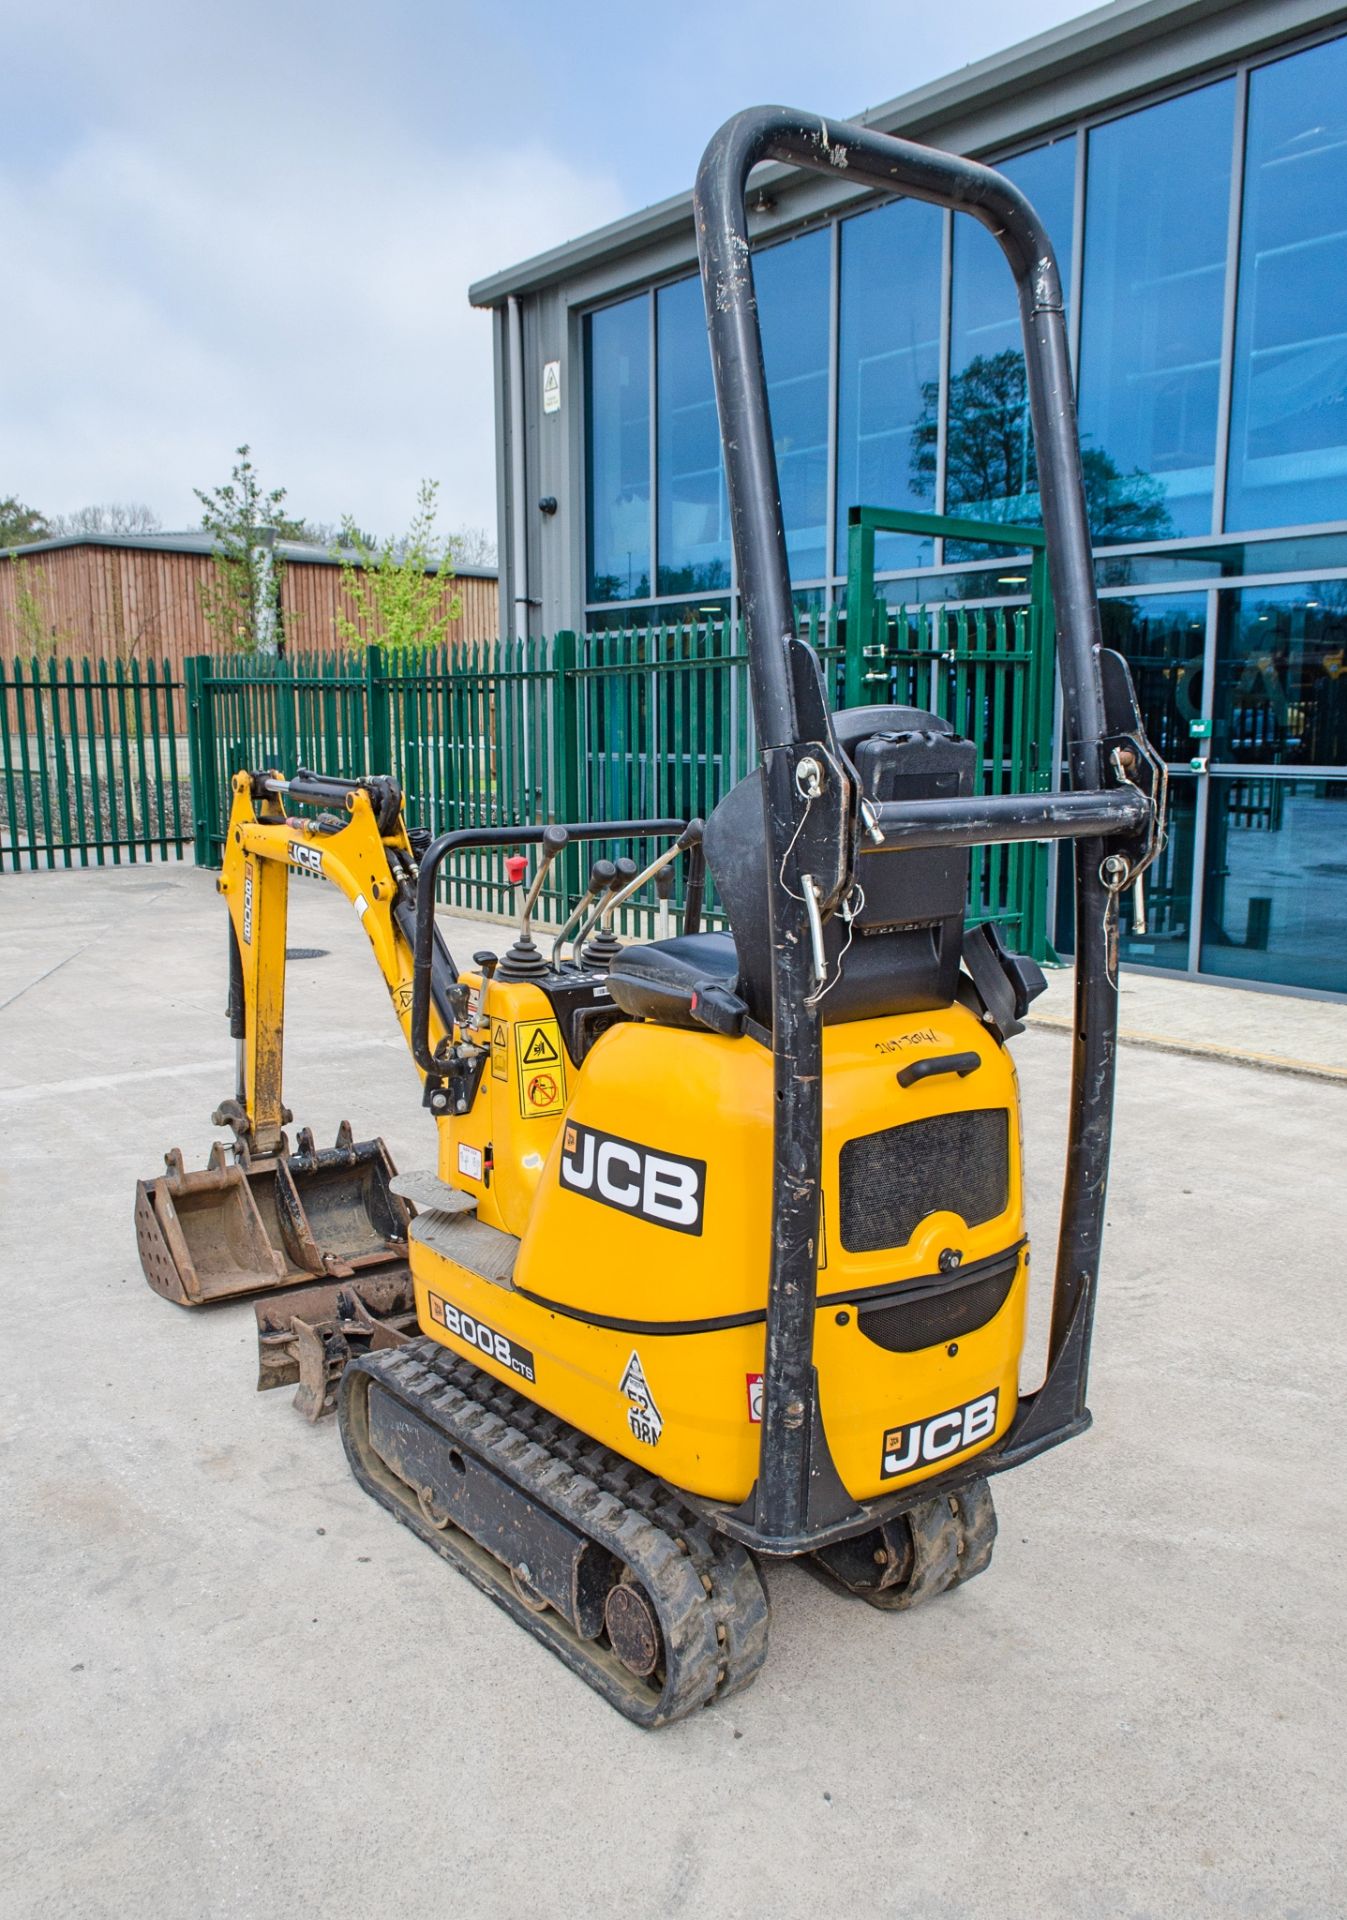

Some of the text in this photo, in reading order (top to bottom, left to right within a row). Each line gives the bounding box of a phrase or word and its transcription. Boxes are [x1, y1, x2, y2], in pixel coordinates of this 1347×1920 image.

[289, 843, 322, 872] JCB
[244, 879, 252, 937] 8008
[562, 1133, 699, 1225] JCB
[884, 1395, 996, 1473] JCB
